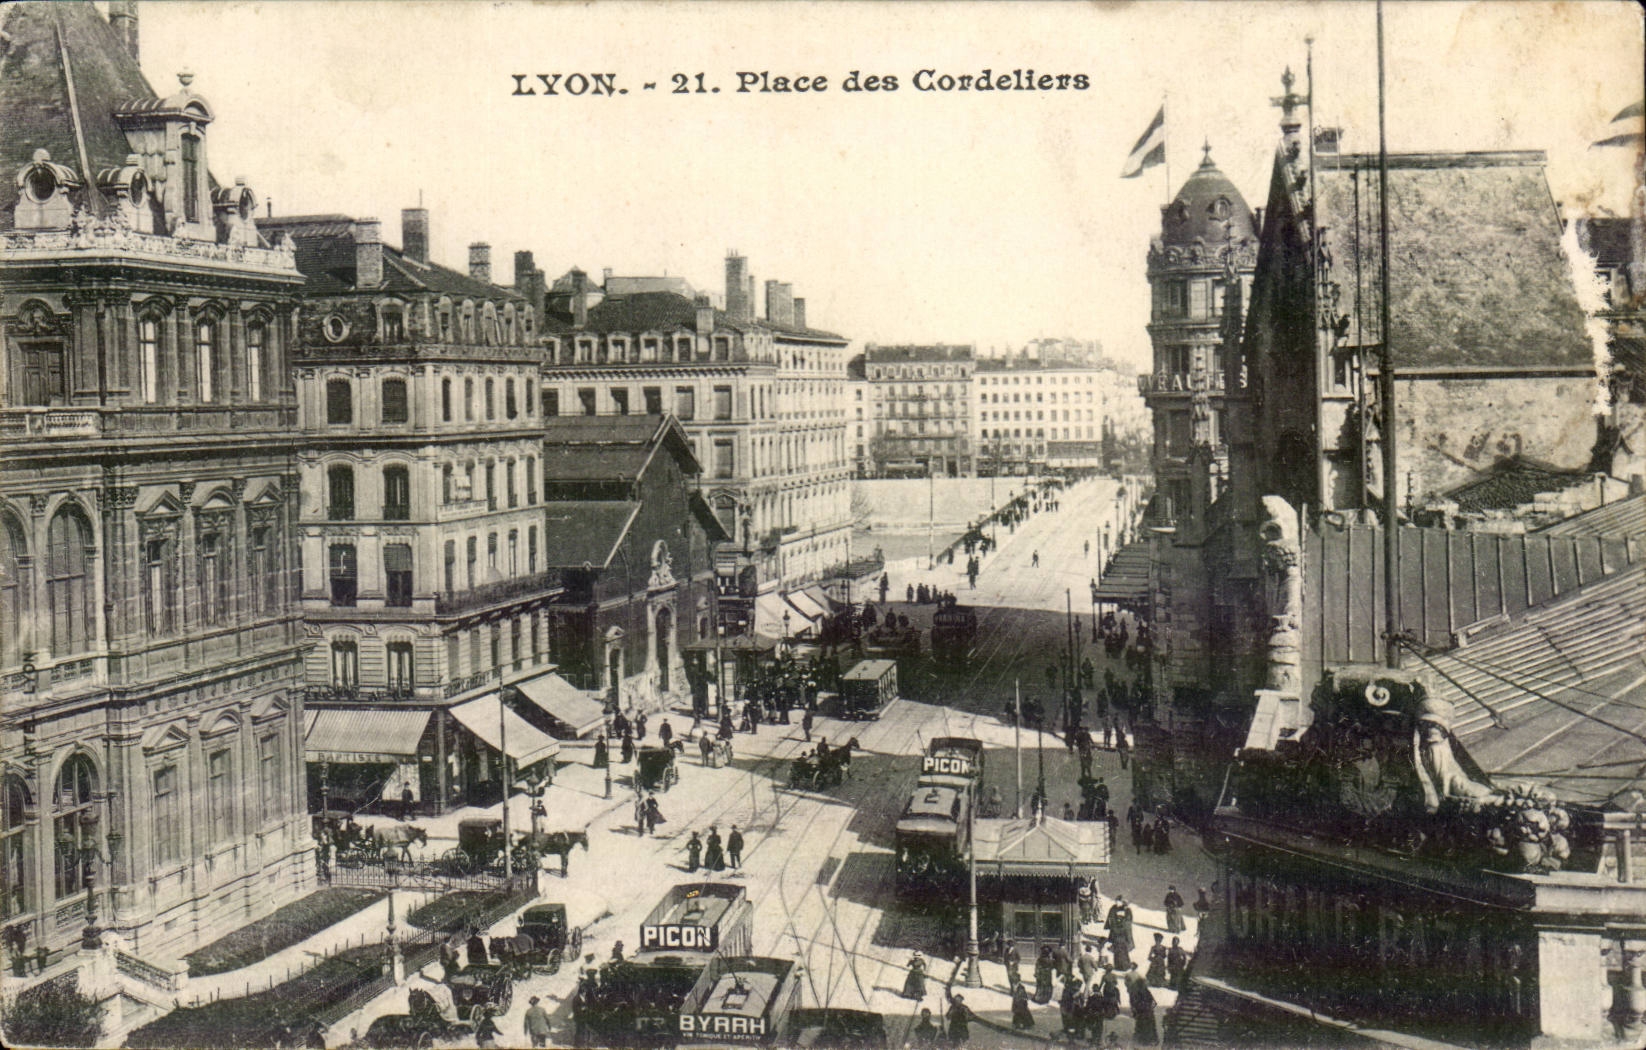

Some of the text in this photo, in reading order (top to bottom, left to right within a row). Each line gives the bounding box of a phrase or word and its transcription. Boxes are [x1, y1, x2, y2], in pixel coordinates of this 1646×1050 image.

[923, 757, 971, 773] PICON
[643, 925, 711, 948] PICON
[679, 1014, 765, 1034] BYRRH
